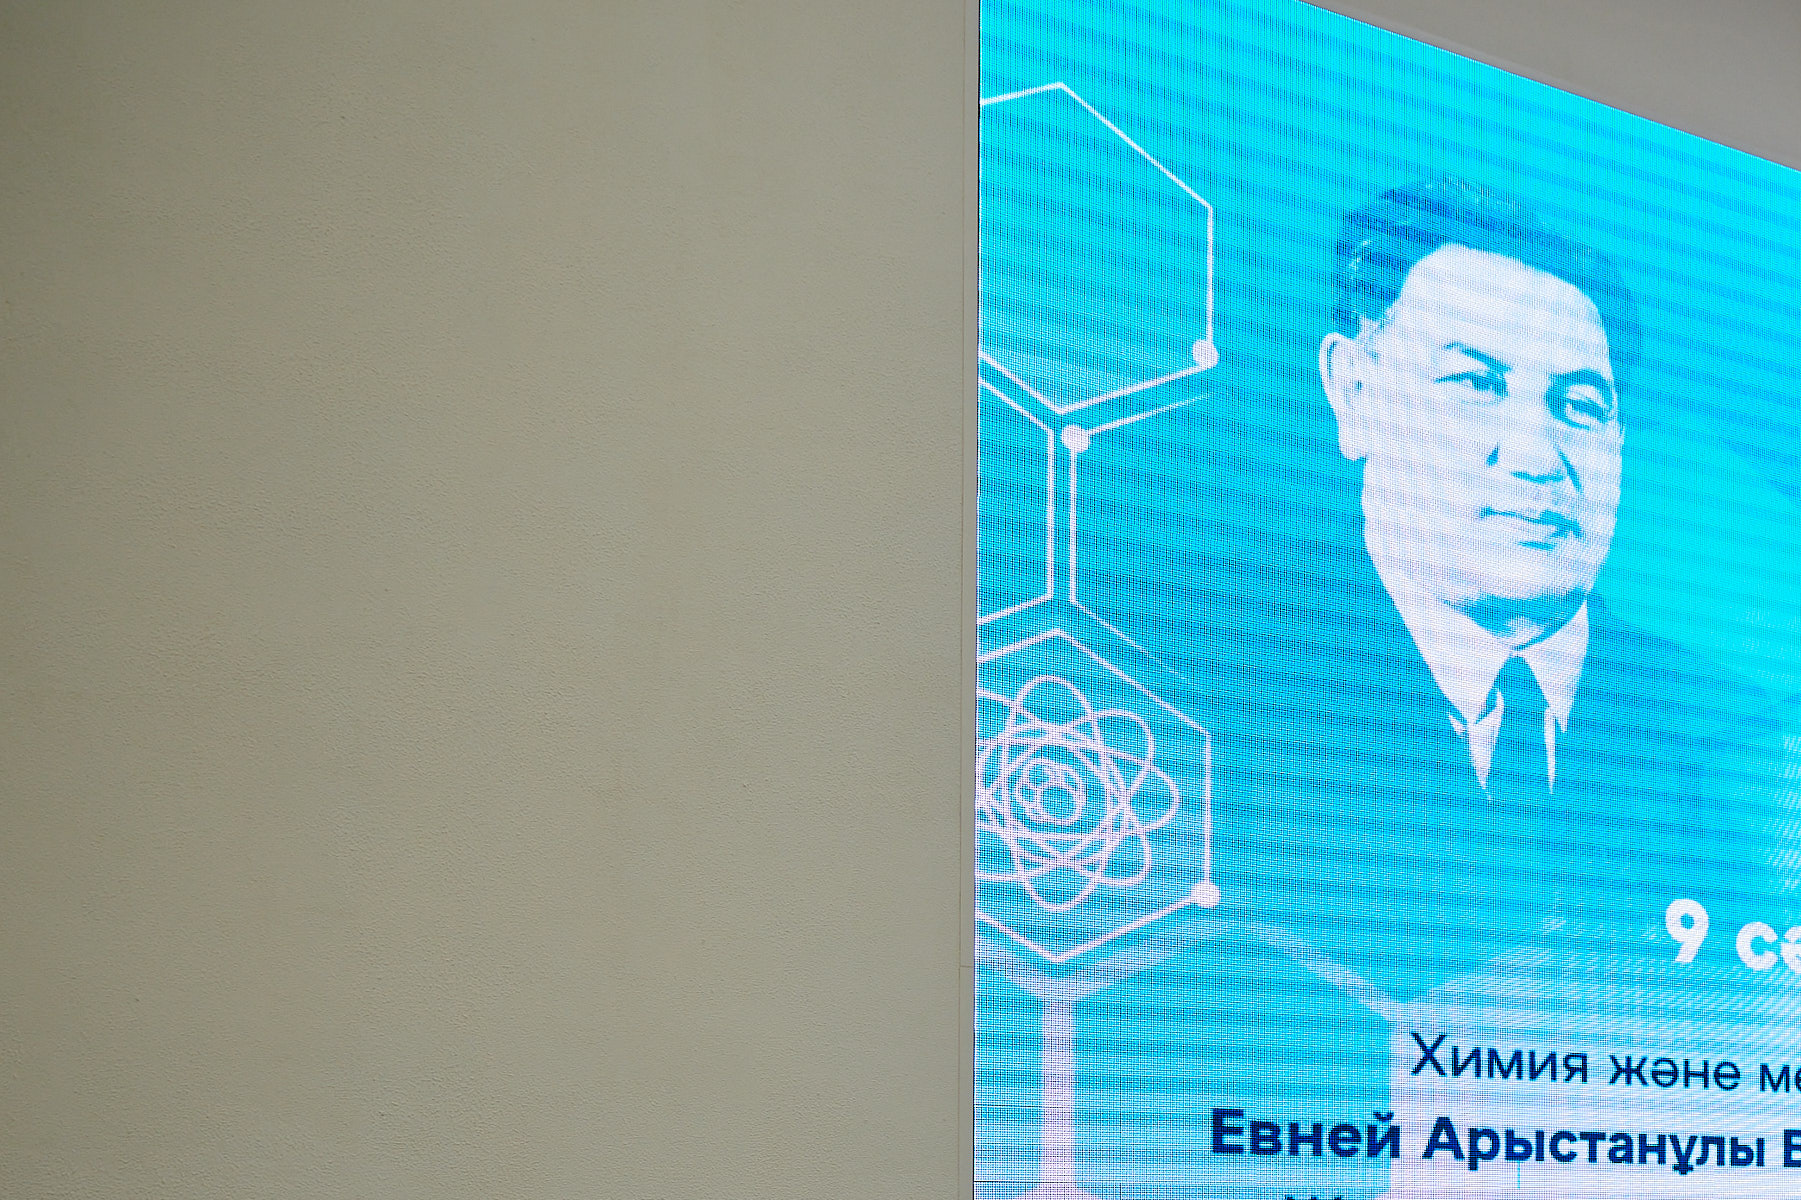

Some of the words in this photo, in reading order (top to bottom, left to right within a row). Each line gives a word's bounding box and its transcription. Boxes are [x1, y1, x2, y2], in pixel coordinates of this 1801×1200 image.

[1665, 898, 1710, 965] 9
[1410, 1033, 1589, 1084] Химия
[1609, 1053, 1741, 1092] және
[1210, 1108, 1401, 1160] Евней
[1422, 1115, 1766, 1176] Арыстанұлы
